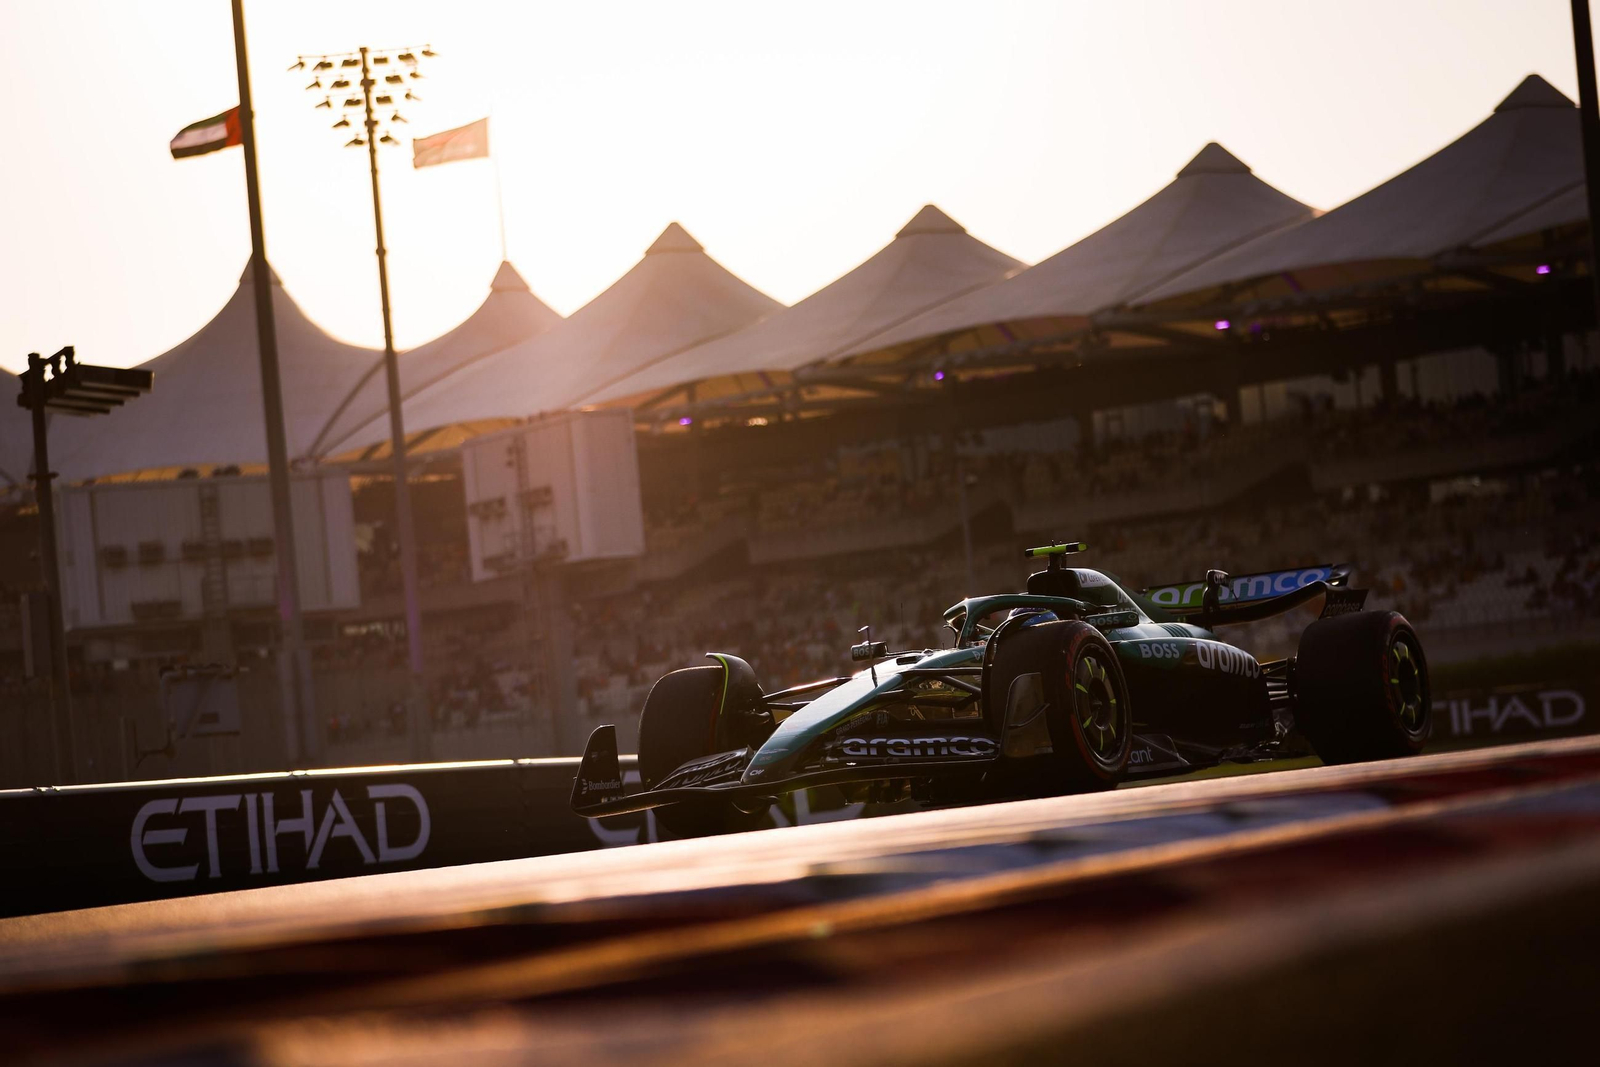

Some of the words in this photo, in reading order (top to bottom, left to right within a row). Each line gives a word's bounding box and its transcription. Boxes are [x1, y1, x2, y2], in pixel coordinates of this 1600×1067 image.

[1089, 616, 1119, 626] BOSS
[1138, 643, 1180, 659] BOSS
[1195, 641, 1261, 679] aramco
[842, 736, 996, 756] aramco
[588, 778, 621, 790] Bombardier
[130, 783, 431, 883] ETIHAD
